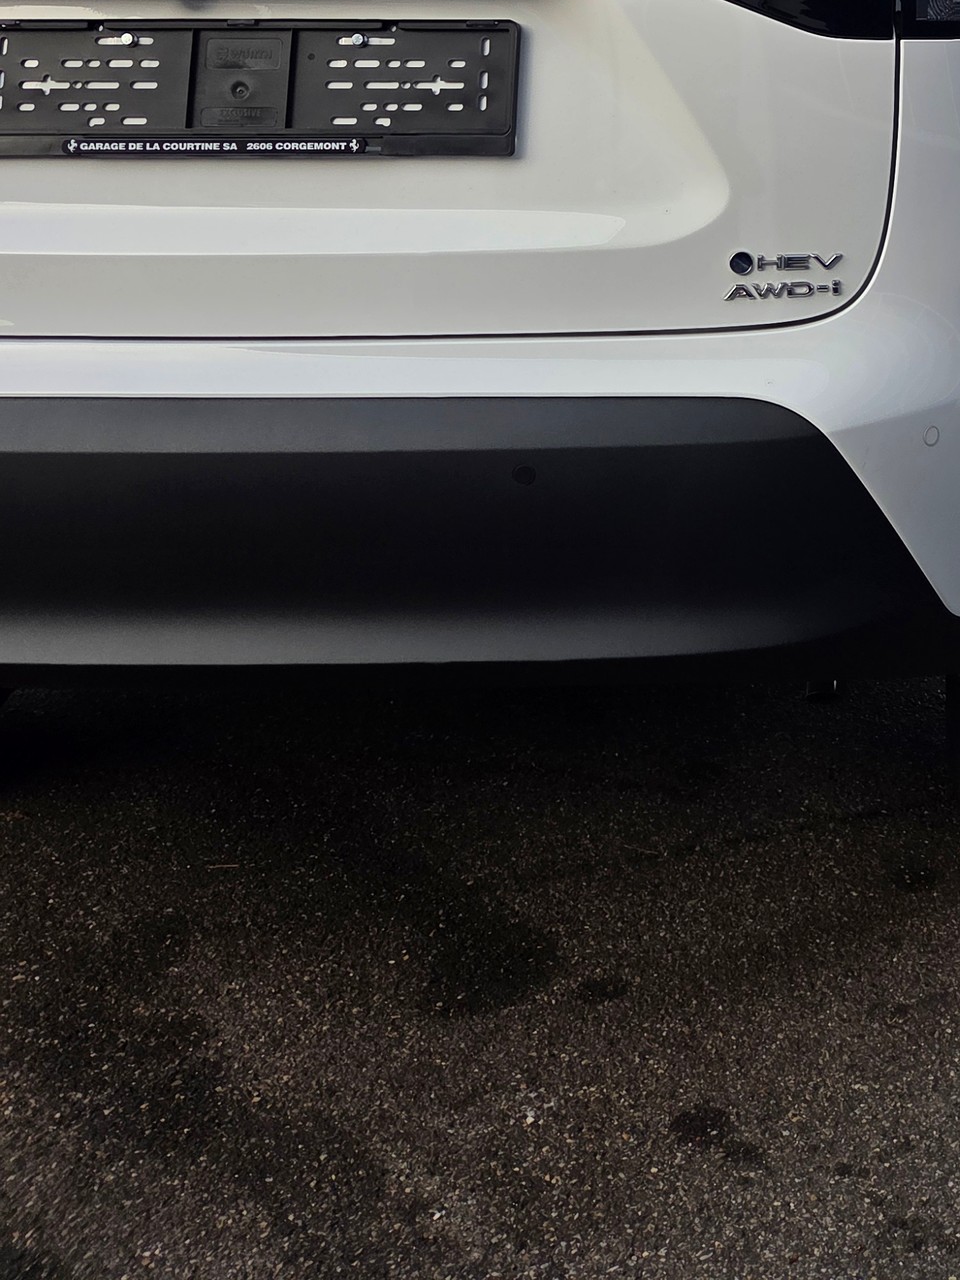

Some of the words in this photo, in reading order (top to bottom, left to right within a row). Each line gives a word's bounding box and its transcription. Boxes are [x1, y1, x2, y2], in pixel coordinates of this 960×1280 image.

[80, 142, 126, 151] GARAGE
[128, 142, 144, 151] DE
[146, 142, 161, 151] LA
[162, 142, 220, 151] COURTINE
[222, 142, 238, 151] SA
[246, 142, 273, 150] 2606
[275, 142, 347, 150] CORGEMONT
[757, 253, 843, 271] HEV
[723, 279, 841, 301] AWD-i
